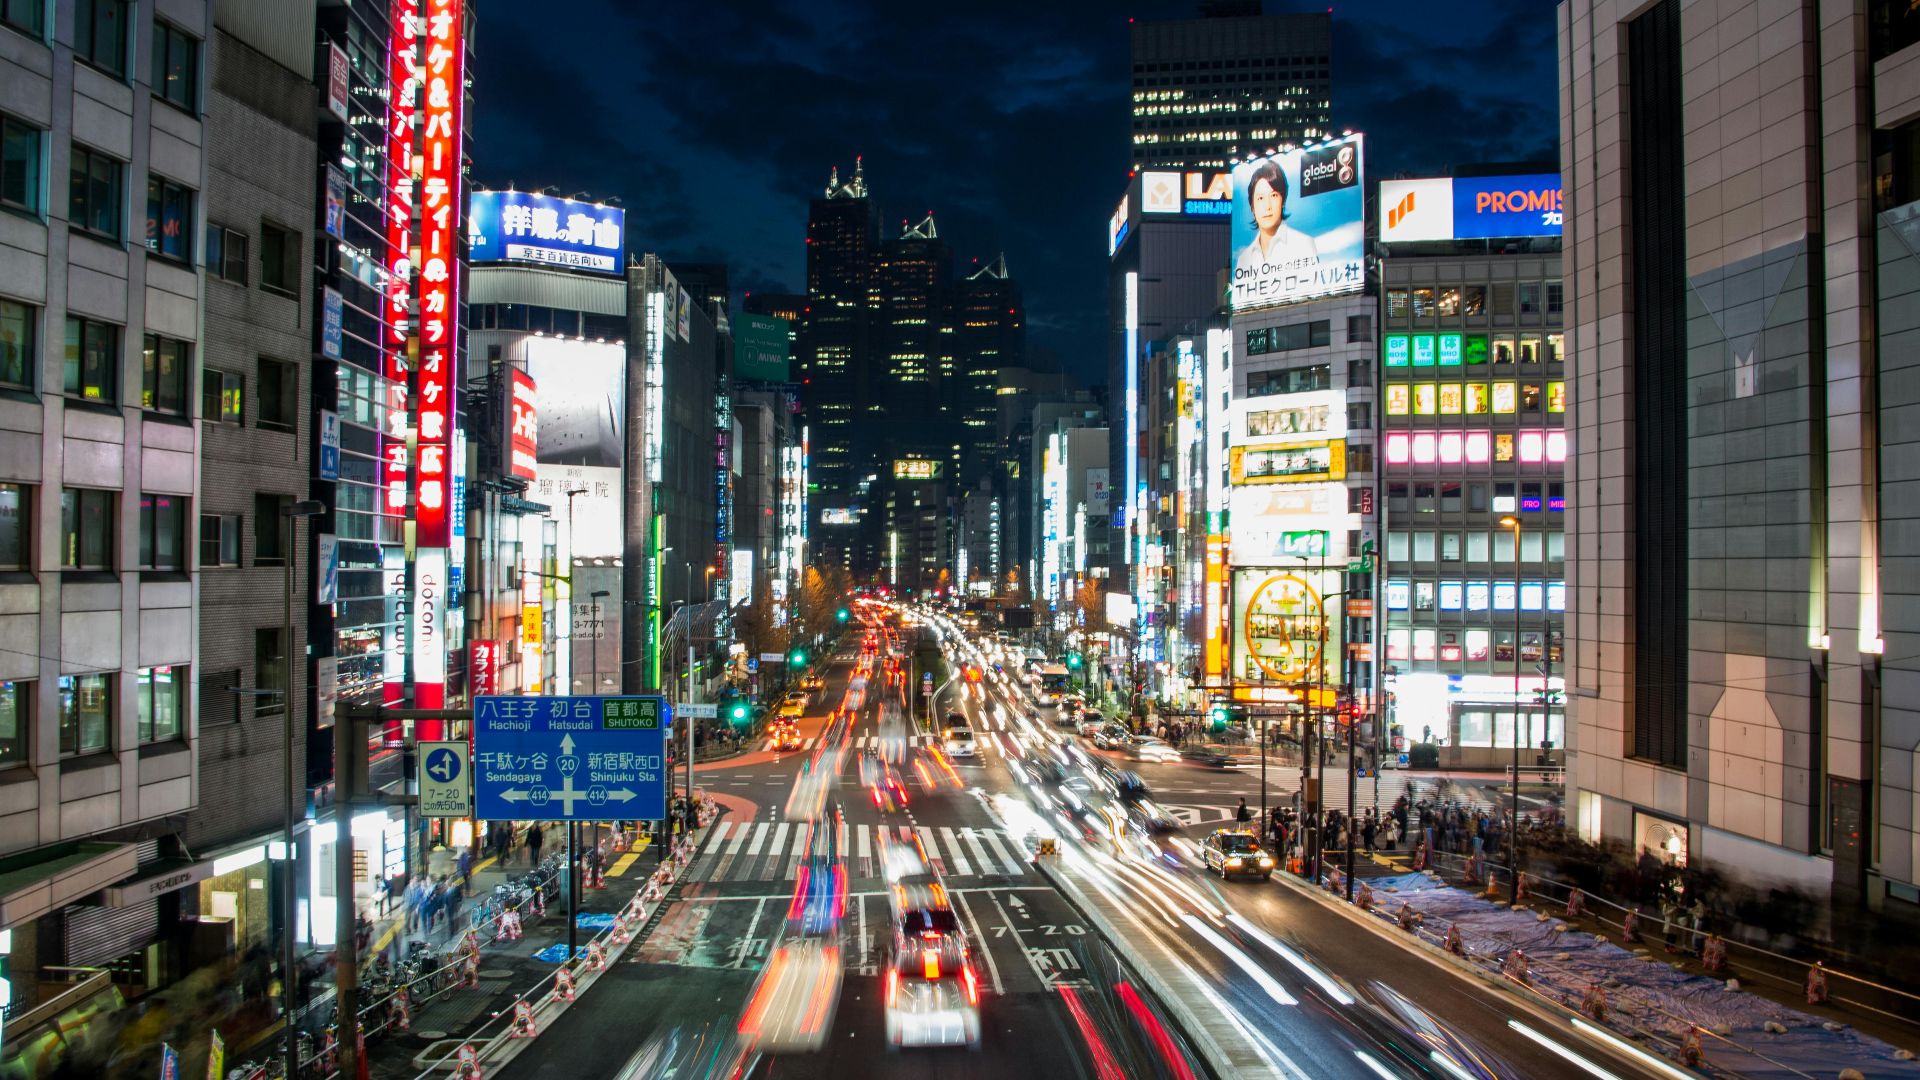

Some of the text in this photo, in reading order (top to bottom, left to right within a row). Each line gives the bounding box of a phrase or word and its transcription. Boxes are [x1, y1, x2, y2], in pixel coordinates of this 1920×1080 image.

[1304, 159, 1338, 186] global
[502, 205, 620, 249] 洋服の青山
[523, 247, 603, 266] 京王百貨店向い
[1235, 266, 1259, 280] Only
[1261, 261, 1282, 274] One
[1235, 263, 1360, 298] THEグローバル社
[758, 352, 782, 363] MIWA
[897, 461, 930, 473] やまや
[1523, 500, 1540, 508] PRO
[1284, 534, 1324, 553] レイク
[421, 574, 437, 656] docomo
[480, 700, 655, 718] 八王子 初台 首都高
[489, 719, 653, 732] Hachioji Hatsudai SHUTOKO
[561, 759, 575, 771] 20
[587, 752, 660, 771] 新宿駅西口
[486, 772, 658, 783] Sendagaya Shinjuku Sta.
[429, 789, 459, 799] 7-20
[531, 790, 605, 801] 414 414
[423, 800, 466, 811] この先50m
